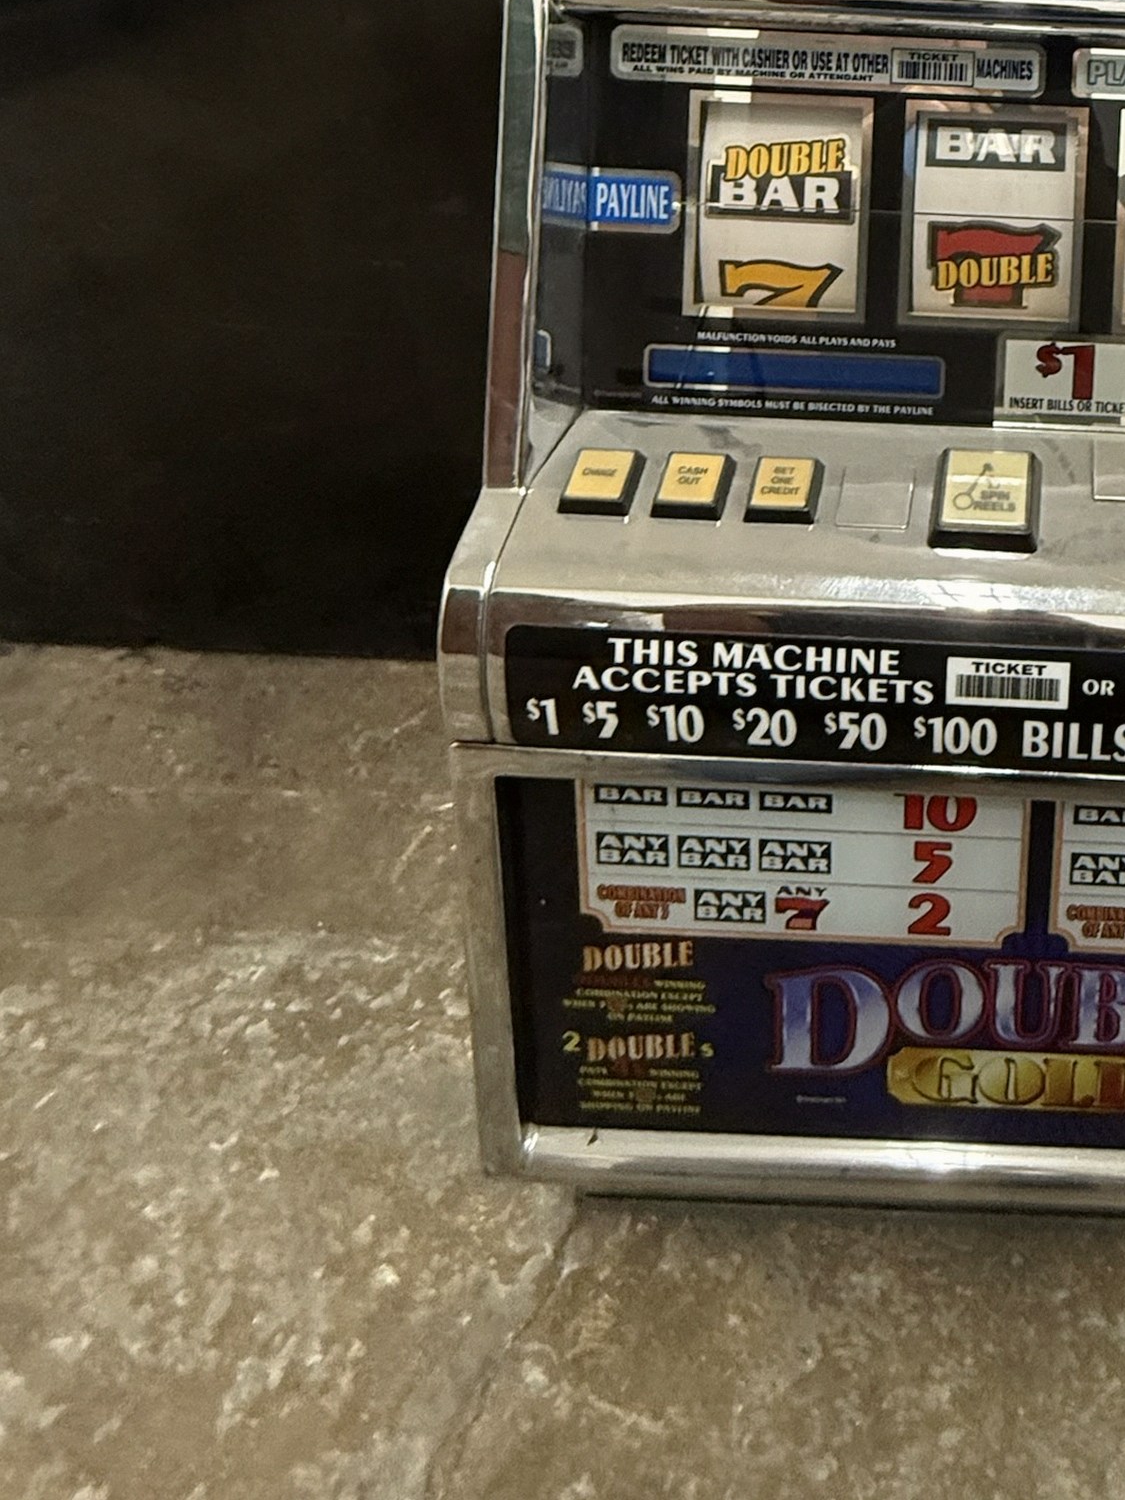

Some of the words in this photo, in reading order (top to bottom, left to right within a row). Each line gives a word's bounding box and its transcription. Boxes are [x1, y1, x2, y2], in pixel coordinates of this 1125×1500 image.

[622, 42, 666, 64] REDEEM
[670, 44, 709, 66] TICKET
[711, 46, 739, 67] WITH
[742, 48, 789, 69] CASHIER
[792, 51, 808, 70] OR
[811, 50, 832, 71] USE
[835, 52, 850, 72] AT
[852, 53, 889, 74] OTHER
[908, 51, 960, 62] TICKET
[975, 58, 1033, 80] MACHINES
[632, 65, 653, 73] ALL
[656, 66, 684, 74] WINS
[688, 67, 713, 75] PAID
[734, 69, 786, 78] MACHINE
[789, 71, 805, 79] OR
[807, 72, 874, 82] ATTENDANT
[725, 138, 846, 181] DOUBLE
[934, 127, 1057, 164] BAR
[596, 182, 669, 220] PAYLINE
[719, 176, 840, 213] BAR
[936, 251, 1055, 292] DOUBLE
[697, 331, 765, 343] MALFUNCTION
[767, 334, 797, 345] VOIDS
[800, 335, 817, 345] ALL
[818, 337, 848, 347] PLAYS
[850, 338, 870, 348] AND
[872, 338, 897, 349] PAYS
[1035, 342, 1096, 400] $1
[651, 395, 669, 405] ALL
[718, 398, 763, 409] SYMBOLS
[765, 400, 790, 410] MUST
[873, 405, 891, 414] THE
[893, 405, 934, 416] PAYLINE
[1009, 396, 1044, 410] INSERT
[1047, 398, 1074, 412] BILLS
[1076, 400, 1092, 412] OR
[607, 637, 698, 668] THIS
[712, 642, 899, 675] MACHINE
[572, 665, 757, 697] ACCEPTS
[770, 674, 934, 705] TICKETS
[971, 661, 1048, 677] TICKET
[1082, 679, 1116, 696] OR
[526, 698, 560, 736] $1
[582, 700, 619, 739] $5
[646, 704, 705, 743] $10
[732, 707, 798, 747] $20
[824, 711, 888, 751] $50
[914, 715, 998, 756] $100
[600, 787, 664, 803] BAR
[681, 791, 746, 807] BAR
[764, 795, 828, 810] BAR
[895, 793, 977, 832] 10
[912, 840, 954, 884] 5
[907, 892, 952, 937] 2
[583, 940, 694, 971] DOUBLE
[587, 1032, 695, 1061] DOUBLE
